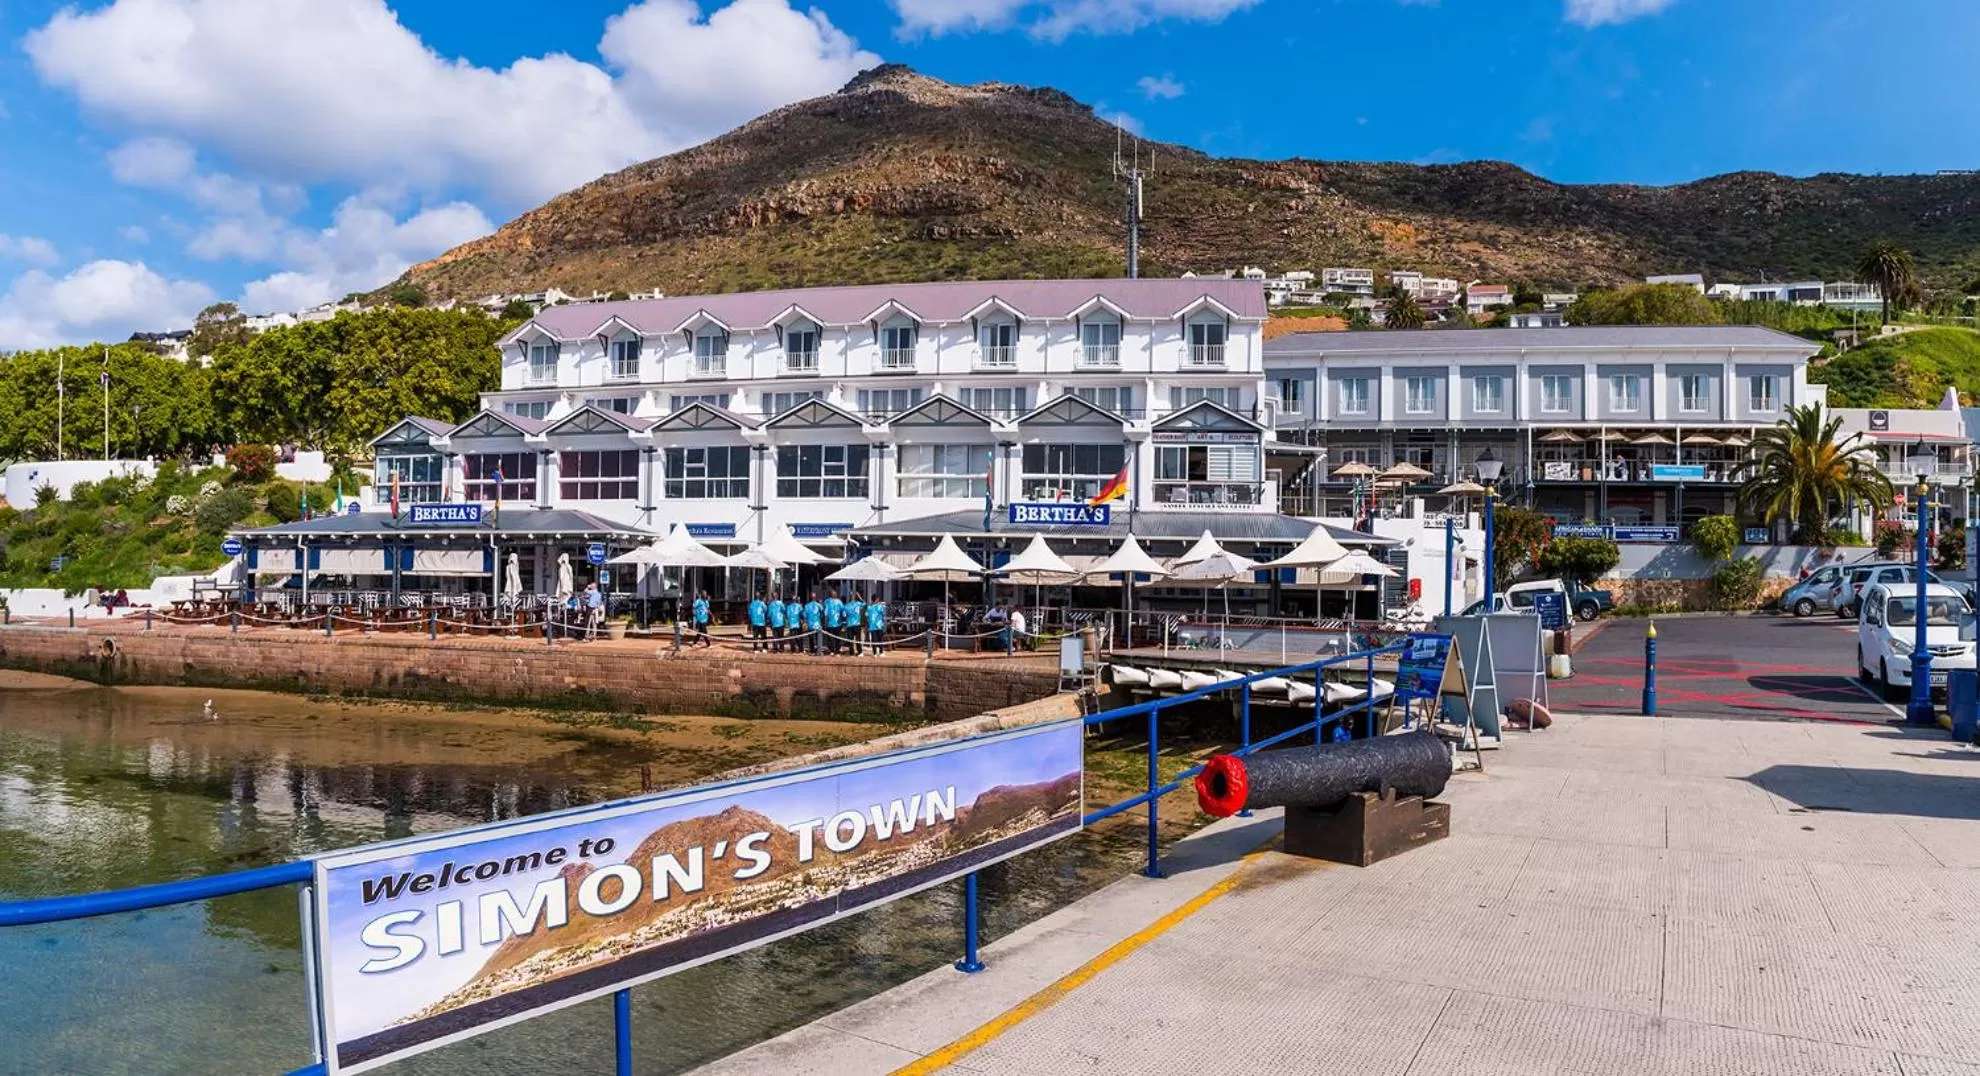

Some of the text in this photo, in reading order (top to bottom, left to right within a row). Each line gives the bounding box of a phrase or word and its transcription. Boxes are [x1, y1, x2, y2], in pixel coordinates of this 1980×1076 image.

[414, 507, 478, 521] BERTHA'S
[1014, 505, 1105, 522] BERTHA'S
[359, 786, 956, 973] SIMON'S TOWN
[361, 836, 615, 904] Welcome to
